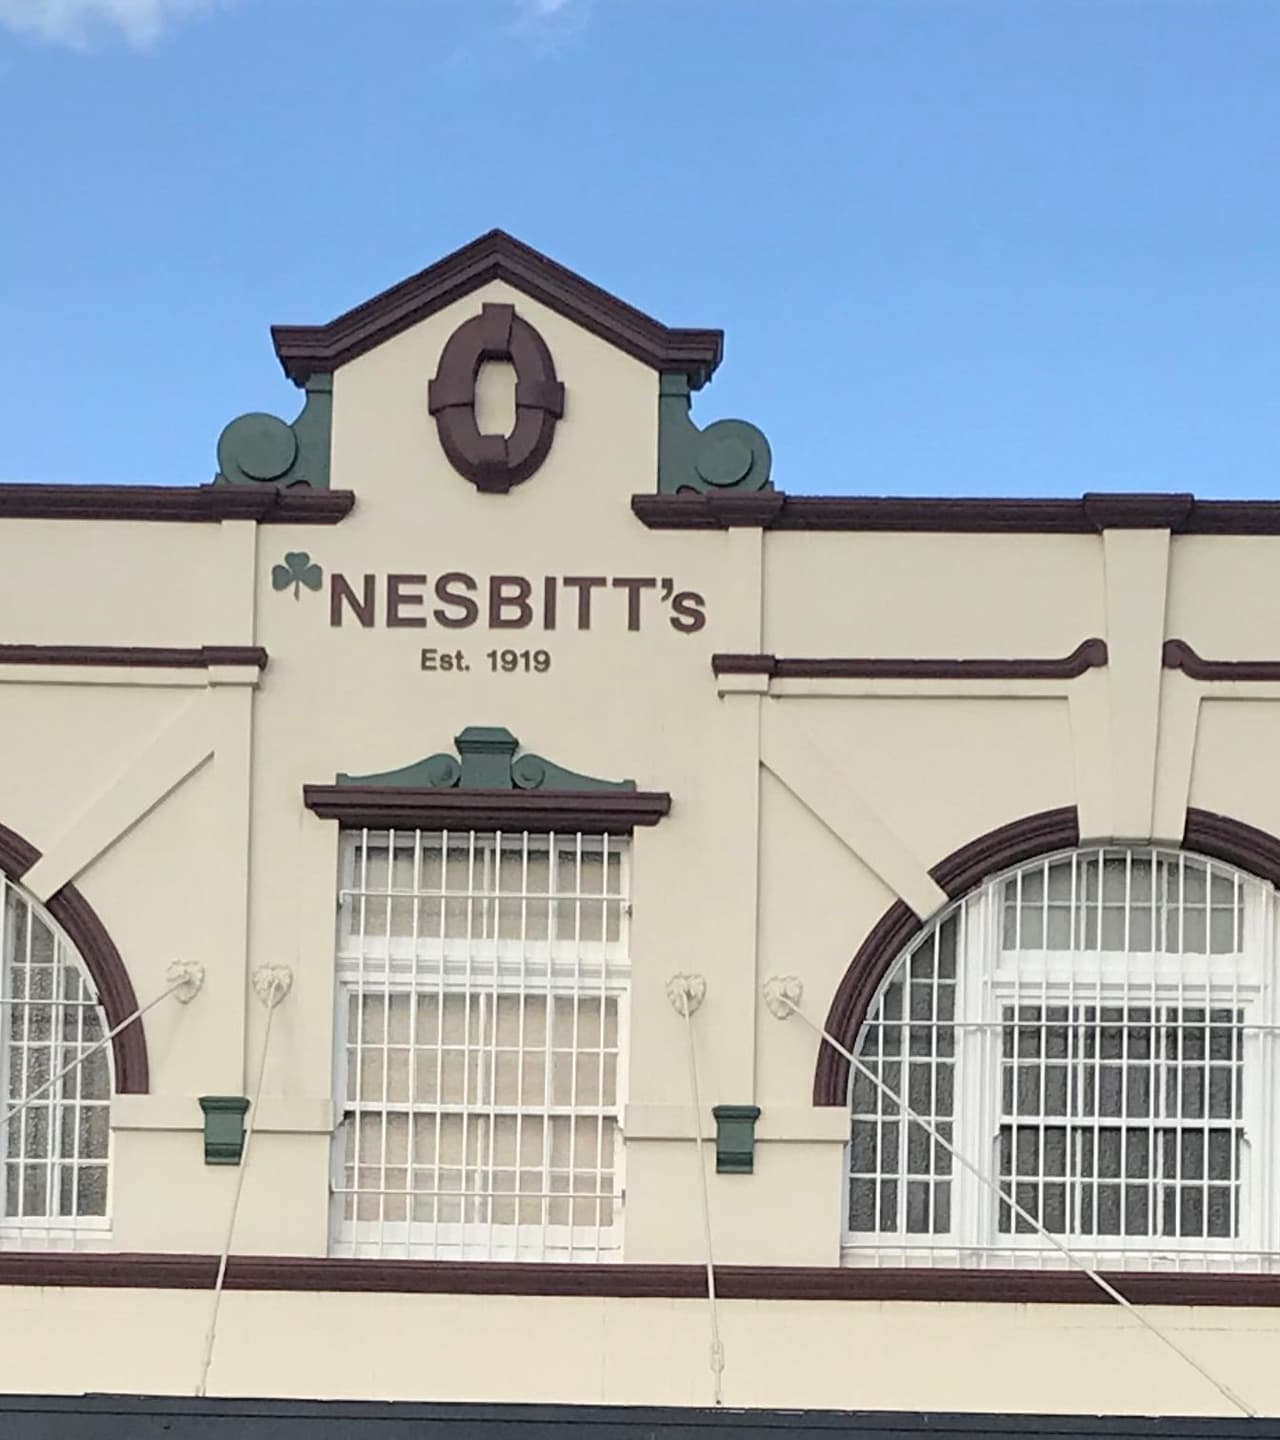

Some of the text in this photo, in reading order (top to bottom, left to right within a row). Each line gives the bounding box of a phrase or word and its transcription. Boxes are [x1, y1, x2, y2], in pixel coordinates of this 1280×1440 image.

[328, 571, 706, 634] NESBITT's
[420, 648, 552, 673] Est. 1919
